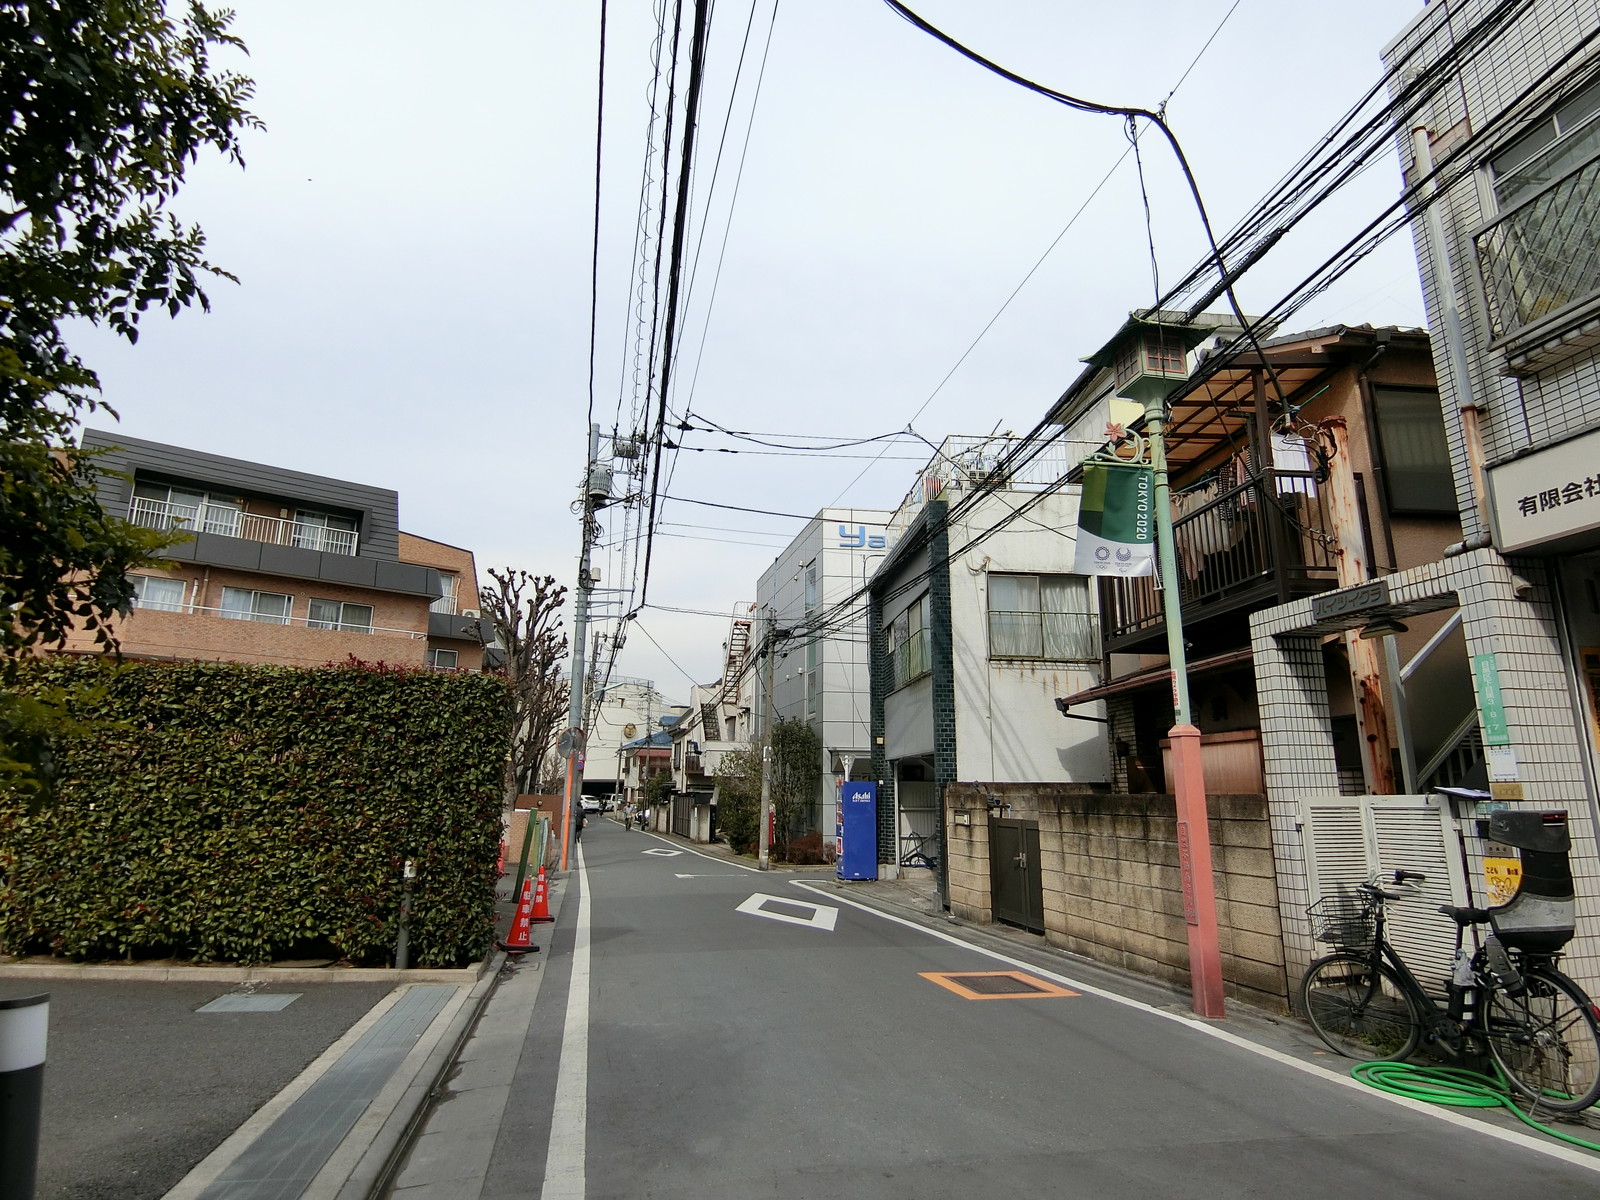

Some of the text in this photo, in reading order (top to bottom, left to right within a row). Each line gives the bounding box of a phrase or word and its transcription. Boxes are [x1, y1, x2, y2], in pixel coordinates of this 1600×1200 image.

[1136, 476, 1148, 540] TOKYO 2020
[1518, 473, 1600, 517] 有限会社
[1317, 587, 1381, 615] ハイツイクラ
[518, 891, 531, 941] 駐車禁止
